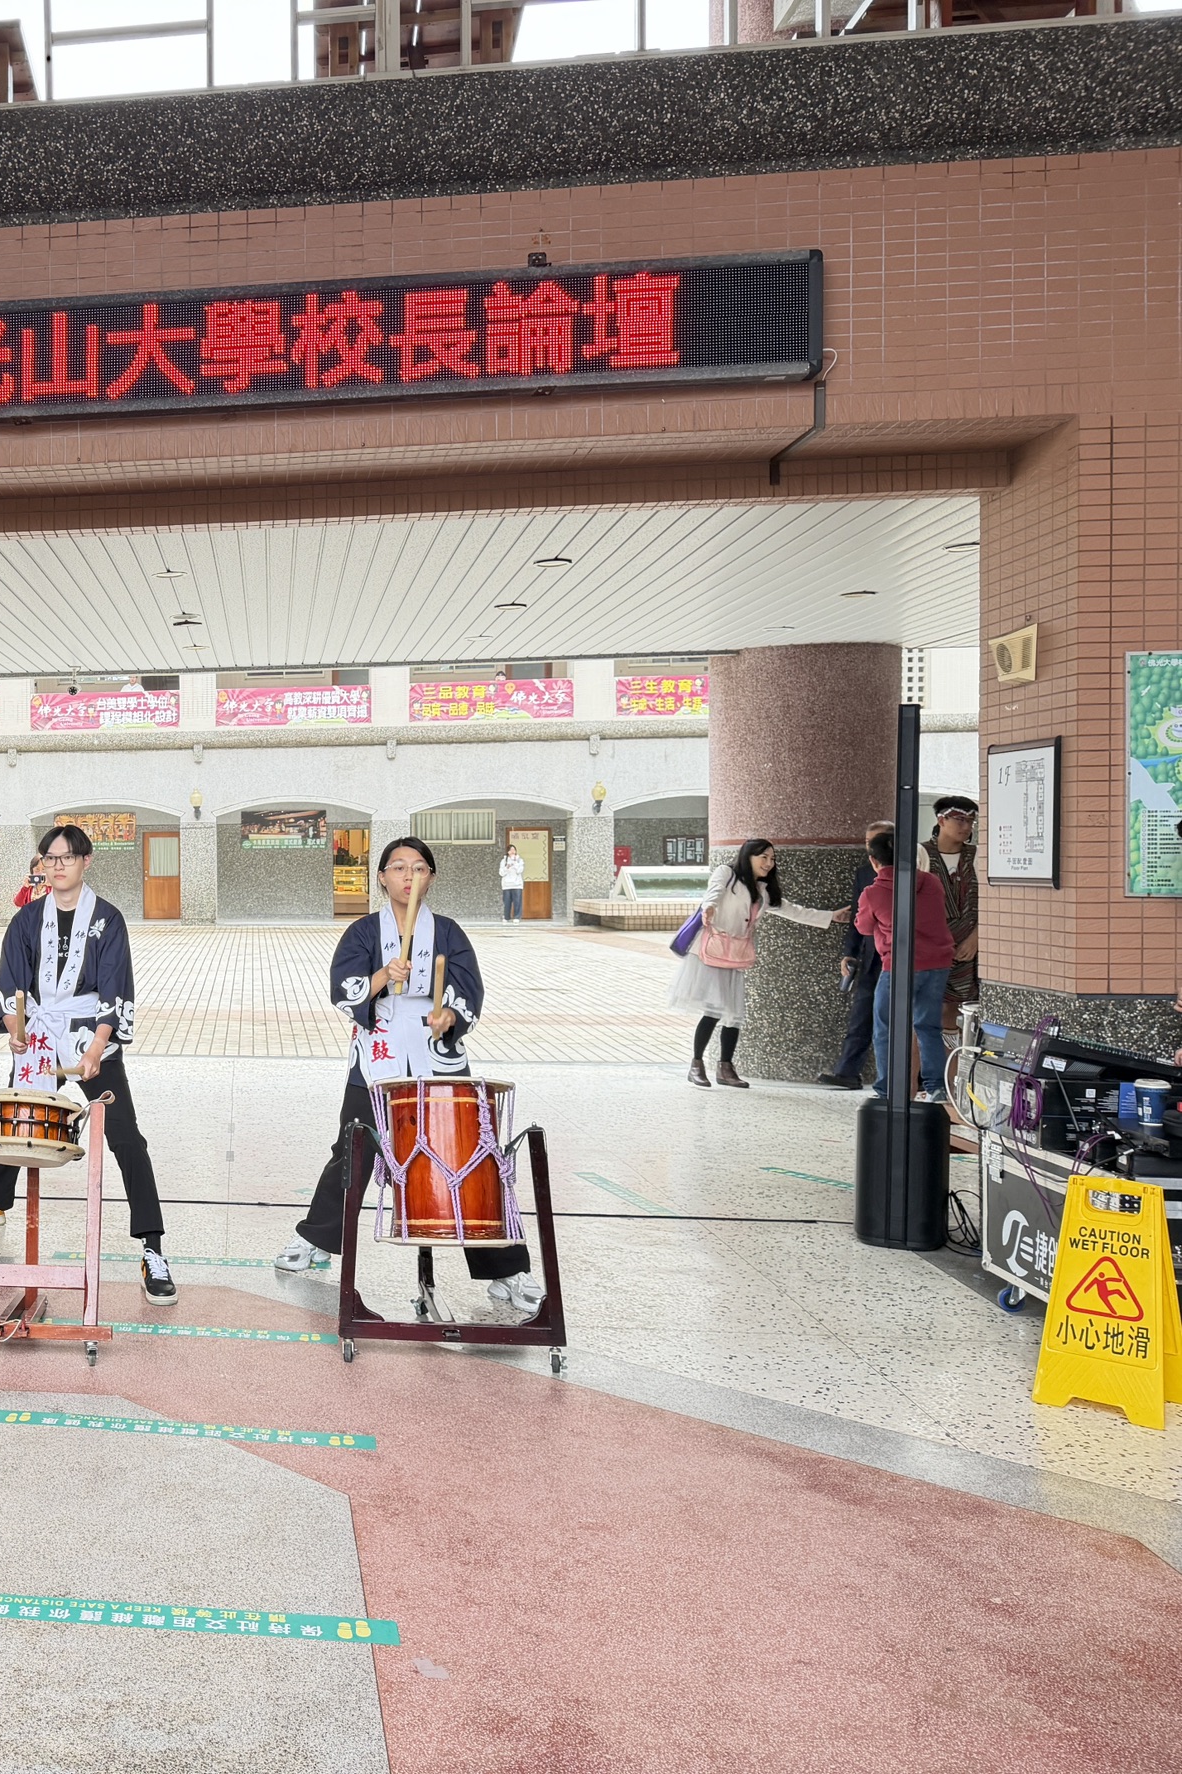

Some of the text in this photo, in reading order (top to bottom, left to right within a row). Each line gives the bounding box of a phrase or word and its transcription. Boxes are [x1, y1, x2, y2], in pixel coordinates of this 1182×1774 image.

[423, 685, 487, 700] 三品教育
[630, 680, 693, 694] 三生教育
[1079, 1226, 1141, 1245] CAUTION
[1069, 1237, 1150, 1259] WET FLOOR
[1056, 1315, 1150, 1359] 小心地滑
[69, 1600, 106, 1609] SAFE
[124, 1605, 161, 1613] KEEP
[170, 1607, 287, 1623] 請在此等候
